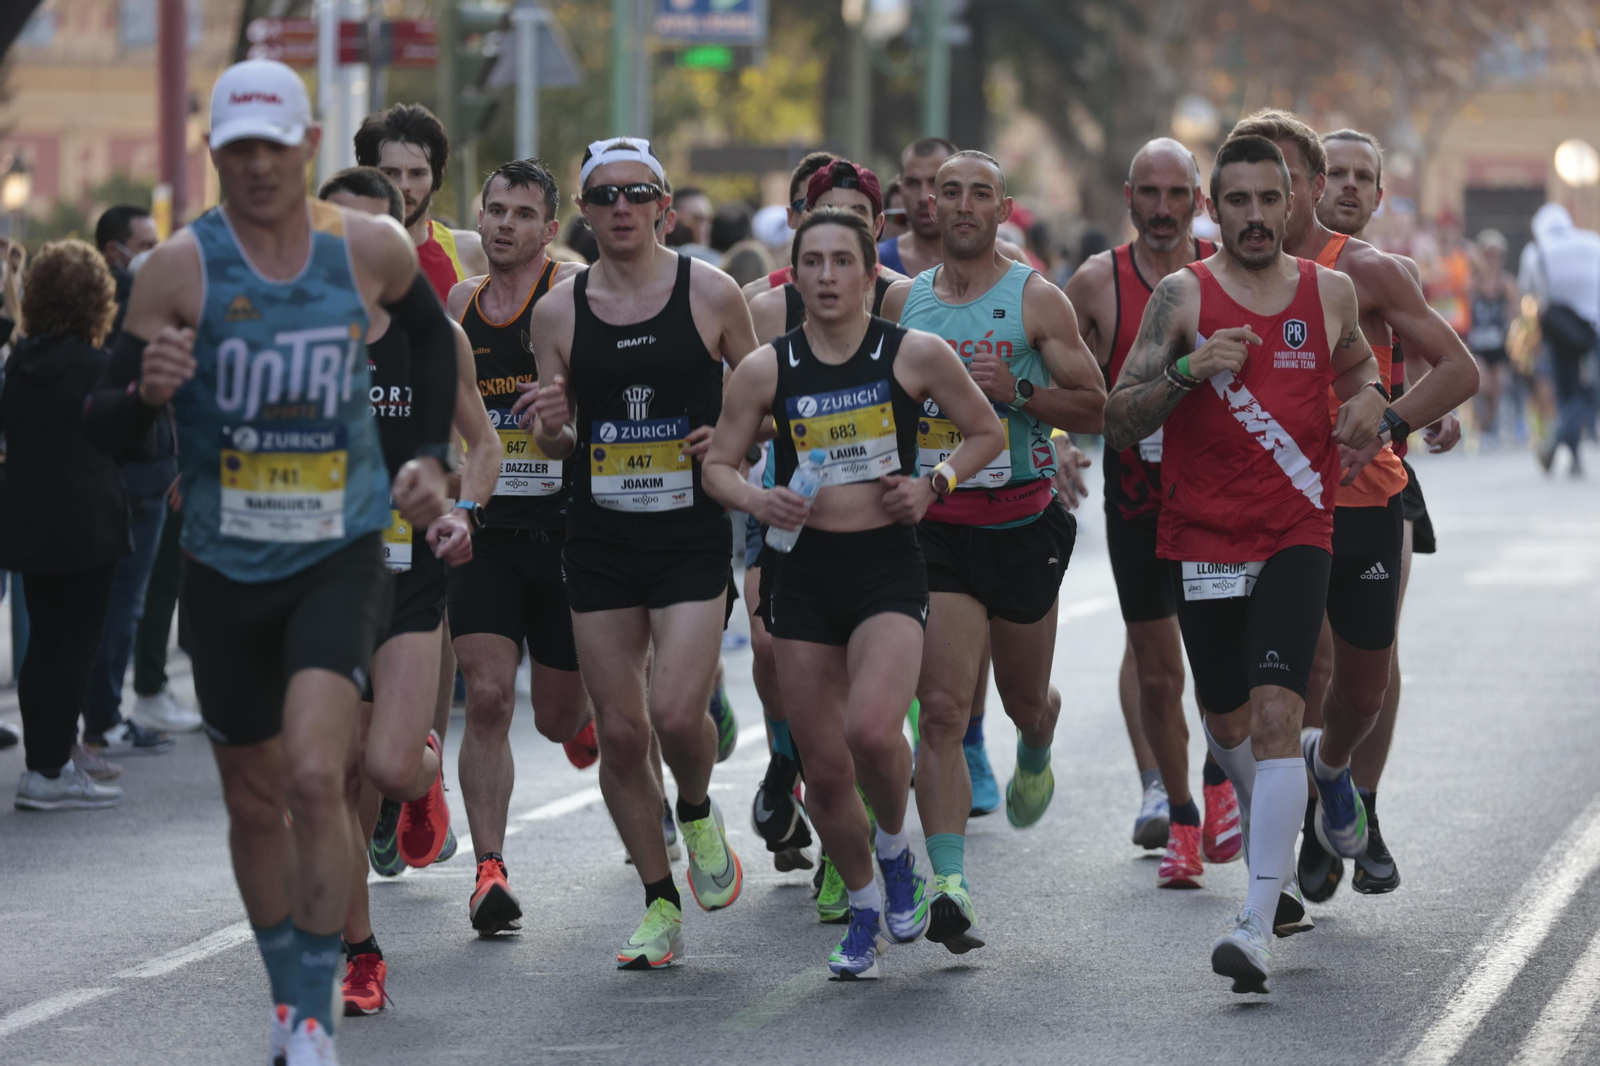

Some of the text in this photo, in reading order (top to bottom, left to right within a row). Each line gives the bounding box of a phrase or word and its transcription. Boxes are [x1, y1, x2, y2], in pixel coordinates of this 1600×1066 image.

[1287, 323, 1303, 342] PR
[617, 336, 648, 349] CRAFT
[1273, 351, 1316, 360] PAQUITO RIBERA
[1273, 360, 1316, 370] RUNNING TEAM
[821, 387, 878, 412] ZURICH
[621, 423, 677, 439] ZURICH
[829, 423, 857, 440] 683
[262, 431, 336, 450] ZURICH
[506, 441, 527, 454] 647
[829, 445, 867, 460] LAURA
[505, 463, 549, 474] DAZZLER
[627, 455, 652, 469] 447
[268, 467, 299, 485] 741
[621, 477, 664, 490] JOAKIM
[1259, 661, 1291, 672] LURBEL
